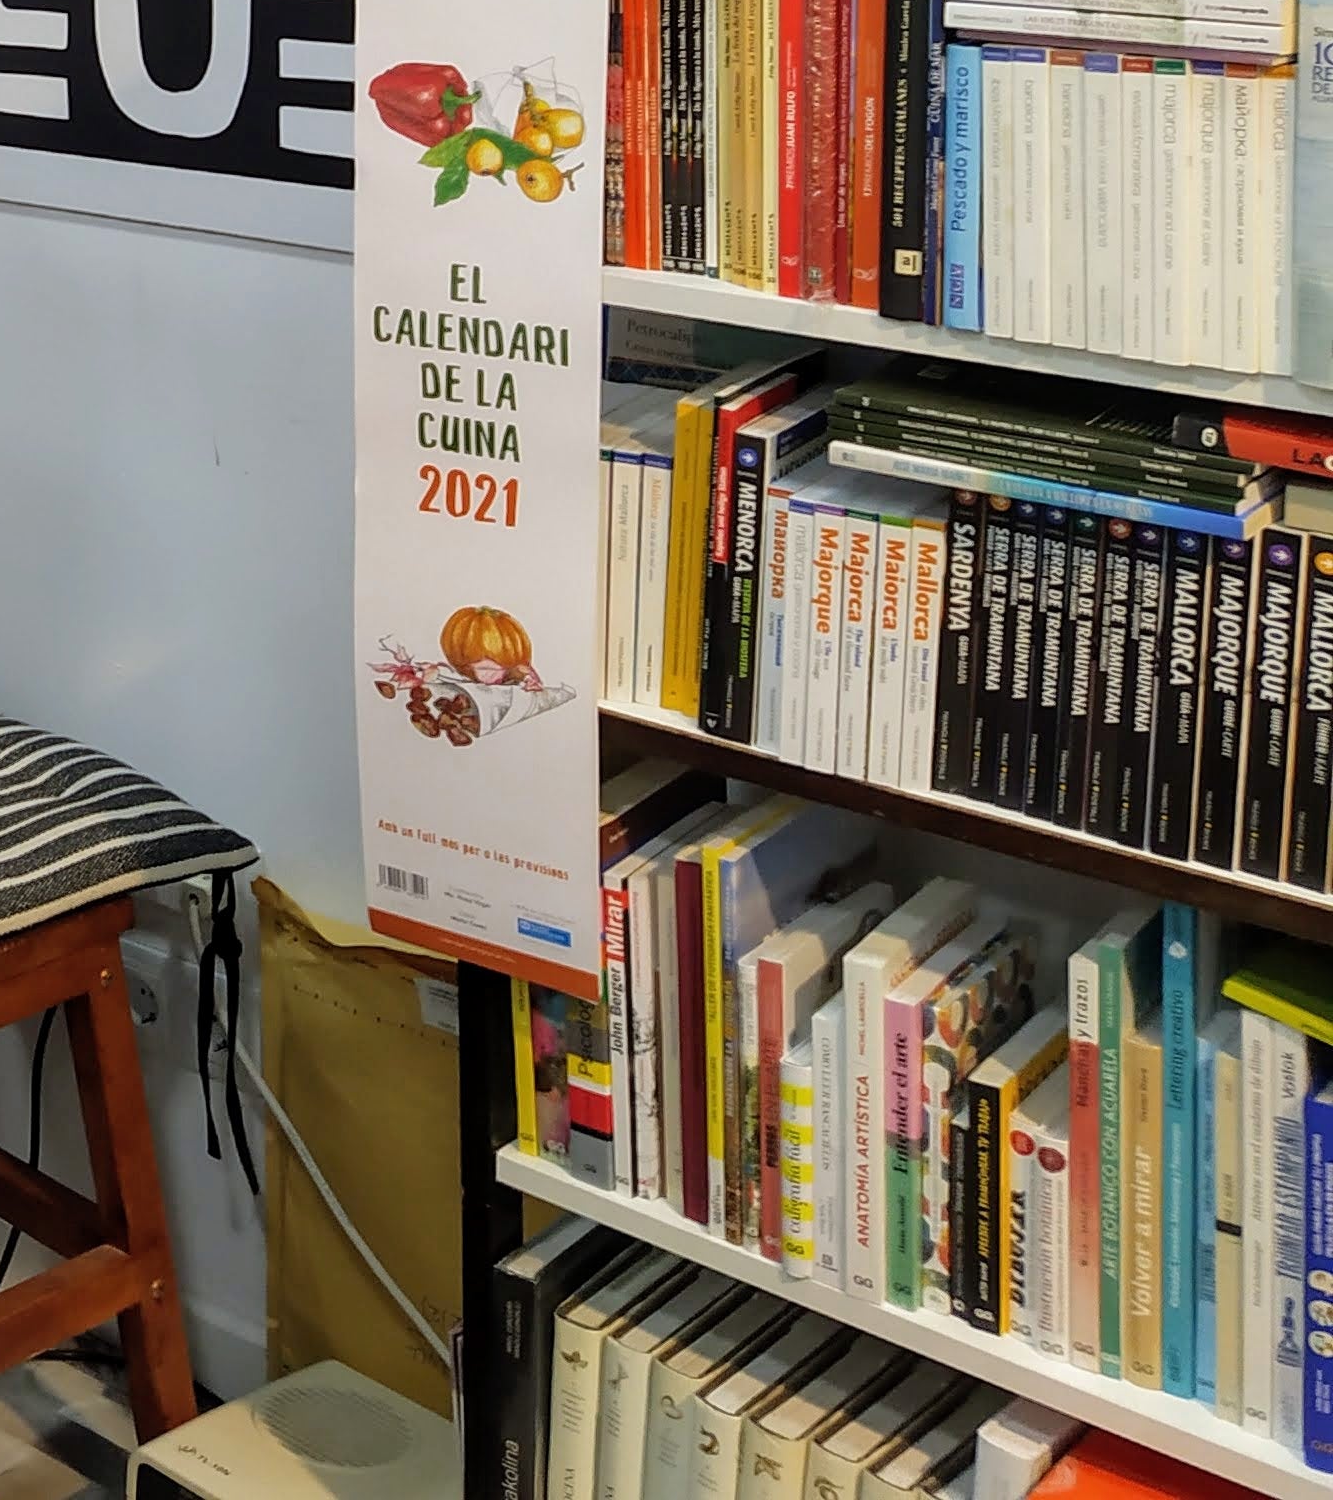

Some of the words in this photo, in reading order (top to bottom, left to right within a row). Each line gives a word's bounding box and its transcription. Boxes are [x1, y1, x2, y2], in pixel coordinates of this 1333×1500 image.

[954, 65, 970, 140] marisco
[1161, 84, 1178, 145] majorca
[1198, 82, 1215, 154] majorque
[1271, 85, 1286, 151] mallorca
[951, 159, 968, 233] Pescado
[449, 262, 487, 304] EL
[373, 305, 569, 367] CALENDARI
[421, 361, 464, 403] DE
[476, 368, 517, 411] LA
[417, 412, 521, 463] CUINA
[418, 464, 519, 528] 2021
[735, 482, 757, 572] MENORCA
[810, 527, 840, 634] Majorque
[844, 532, 871, 623] Majorca
[948, 522, 976, 632] SARDENYA
[992, 526, 1010, 572] SERRA
[882, 539, 906, 631] Maiorca
[913, 542, 939, 641] Mallorca
[990, 574, 1007, 595] DE
[1141, 561, 1161, 608] SERRA
[984, 596, 1005, 691] TRAMUNTANA
[1140, 610, 1158, 632] DE
[1169, 568, 1201, 686] MALLORCA
[1211, 574, 1245, 696] MAJORQUE
[1257, 581, 1295, 706] MAJORQUE
[1305, 590, 1333, 712] MALLORCA
[1132, 633, 1156, 733] TRAMUNTANA
[378, 819, 398, 834] Amb
[401, 828, 413, 838] un
[417, 828, 436, 845] full
[463, 843, 481, 857] per
[494, 849, 510, 864] les
[514, 857, 570, 881] previsions
[604, 897, 625, 959] Mirar
[608, 966, 625, 1018] Berger
[1072, 979, 1090, 1026] trazos
[1168, 989, 1185, 1046] creativo
[608, 1021, 624, 1055] John
[892, 1032, 908, 1069] arte
[891, 1071, 909, 1088] el
[1101, 1048, 1118, 1124] ACUARELA
[1167, 1049, 1188, 1110] Lettering
[1280, 1052, 1297, 1099] Vostok
[852, 1076, 870, 1160] ARTÍSTICA
[891, 1091, 911, 1176] Entender
[1102, 1127, 1117, 1159] CON
[853, 1164, 871, 1248] ANATOMÍA
[1034, 1178, 1054, 1246] botánica
[1100, 1162, 1118, 1237] BOTÁNICO
[1131, 1146, 1153, 1214] mirar
[1102, 1241, 1119, 1279] ARTE
[1135, 1220, 1151, 1237] a
[1035, 1248, 1055, 1333] Ilustración
[1130, 1243, 1153, 1317] Volver
